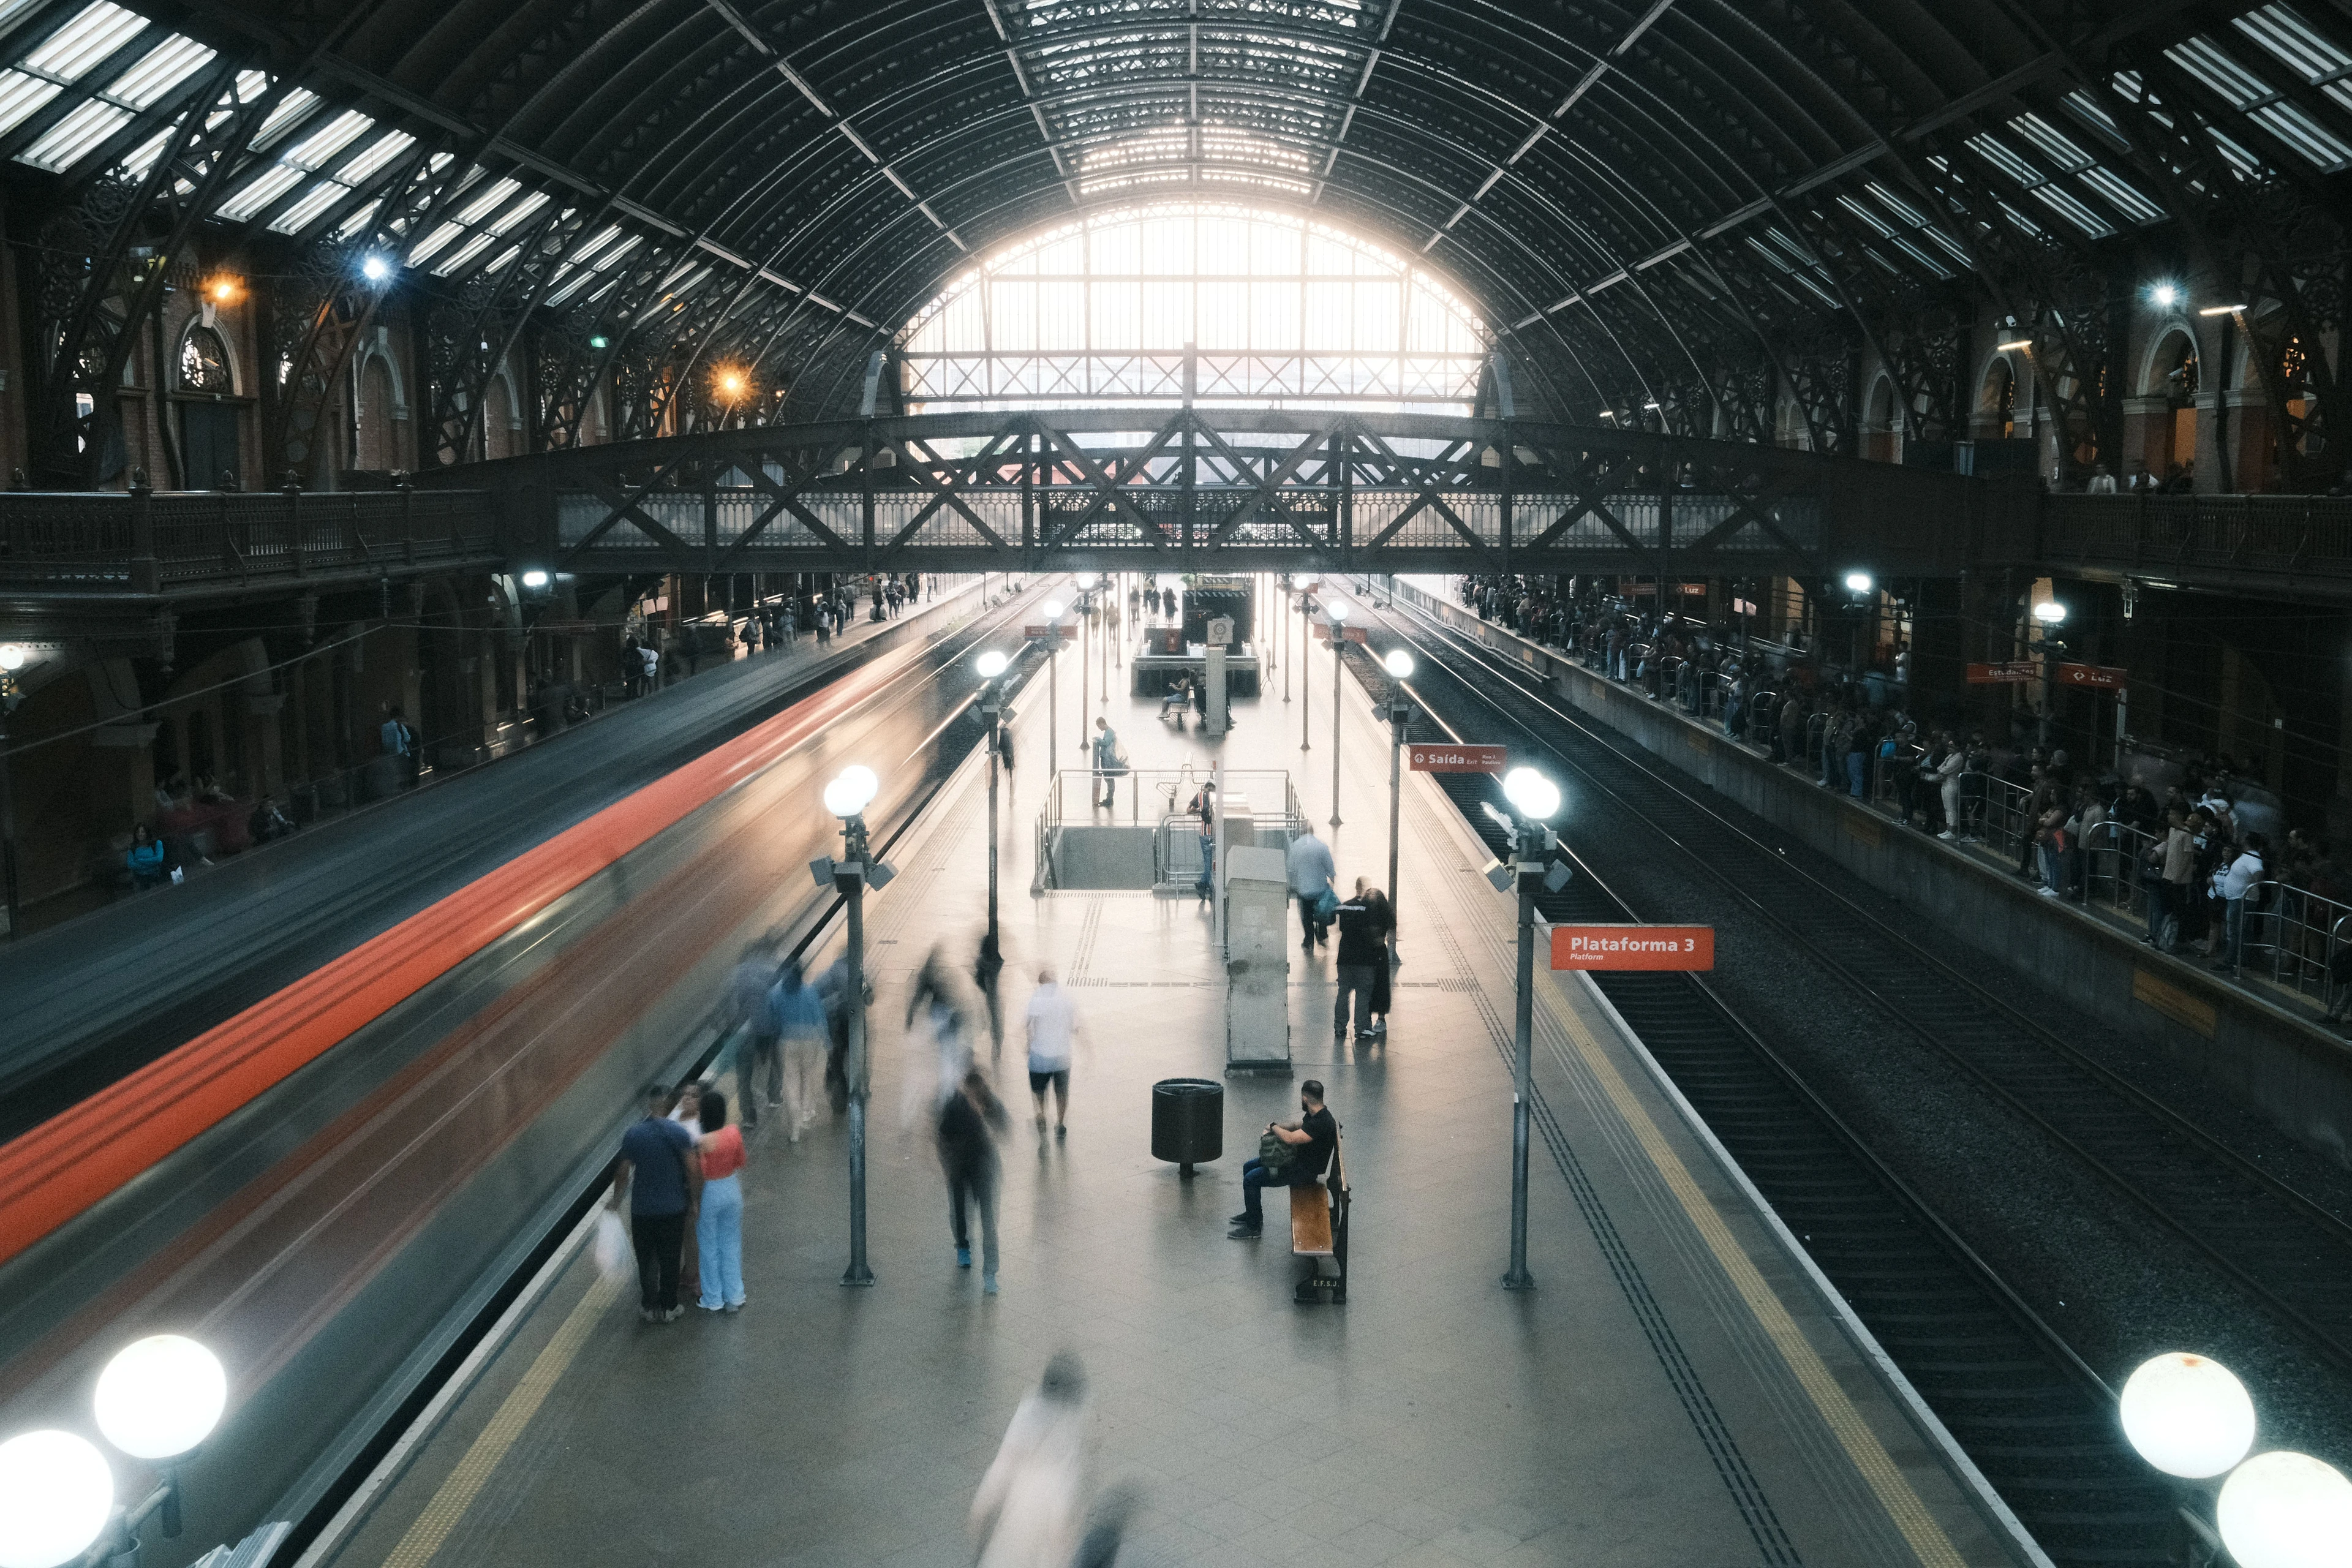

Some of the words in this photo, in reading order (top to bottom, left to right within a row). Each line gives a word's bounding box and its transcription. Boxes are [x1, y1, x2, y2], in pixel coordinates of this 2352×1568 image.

[2091, 673, 2113, 683] Luz
[1428, 754, 1464, 764] Saída
[1571, 937, 1678, 952] Plataforma
[1684, 938, 1695, 952] 3
